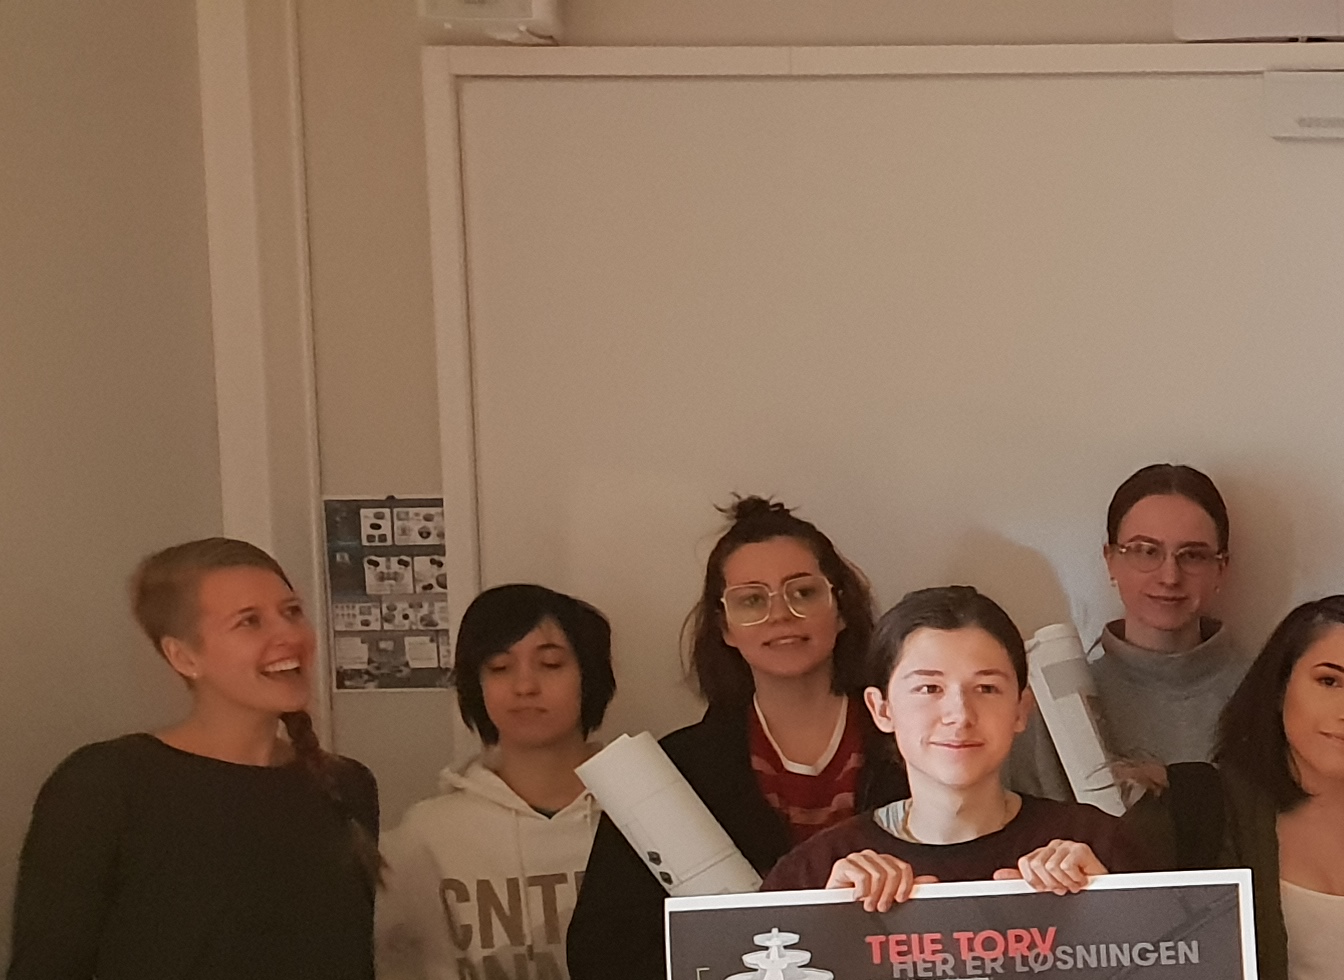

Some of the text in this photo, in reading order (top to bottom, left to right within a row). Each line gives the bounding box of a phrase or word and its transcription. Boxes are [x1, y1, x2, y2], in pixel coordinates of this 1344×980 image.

[439, 871, 587, 951] CNT
[865, 926, 1057, 965] TEIE TORV
[892, 940, 1200, 978] HER ER LØSNINGEN
